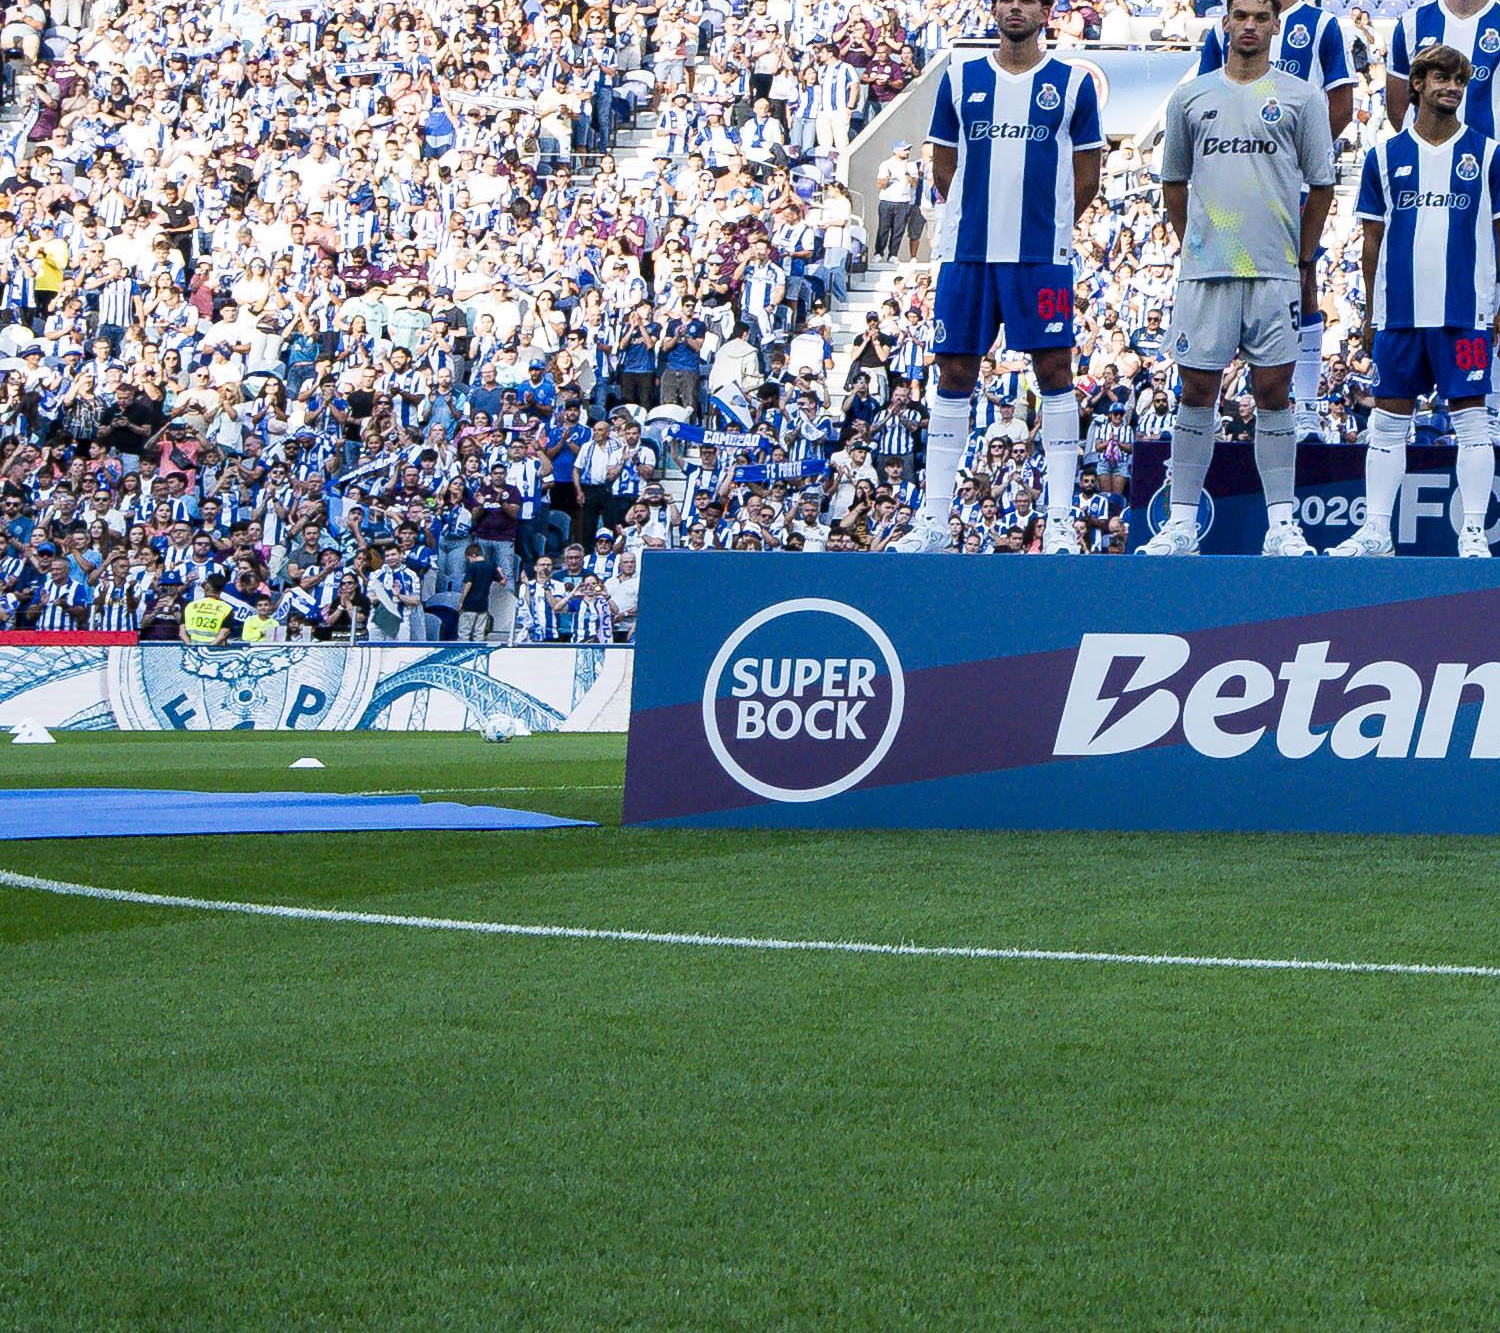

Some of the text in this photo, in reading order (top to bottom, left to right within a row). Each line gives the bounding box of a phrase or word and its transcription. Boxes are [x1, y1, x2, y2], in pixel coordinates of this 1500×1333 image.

[969, 119, 1049, 142] Betano
[1202, 136, 1279, 157] Betano
[1397, 190, 1471, 211] Betano
[1037, 287, 1071, 321] 64
[731, 657, 877, 699] SUPER
[735, 699, 869, 742] BOCK
